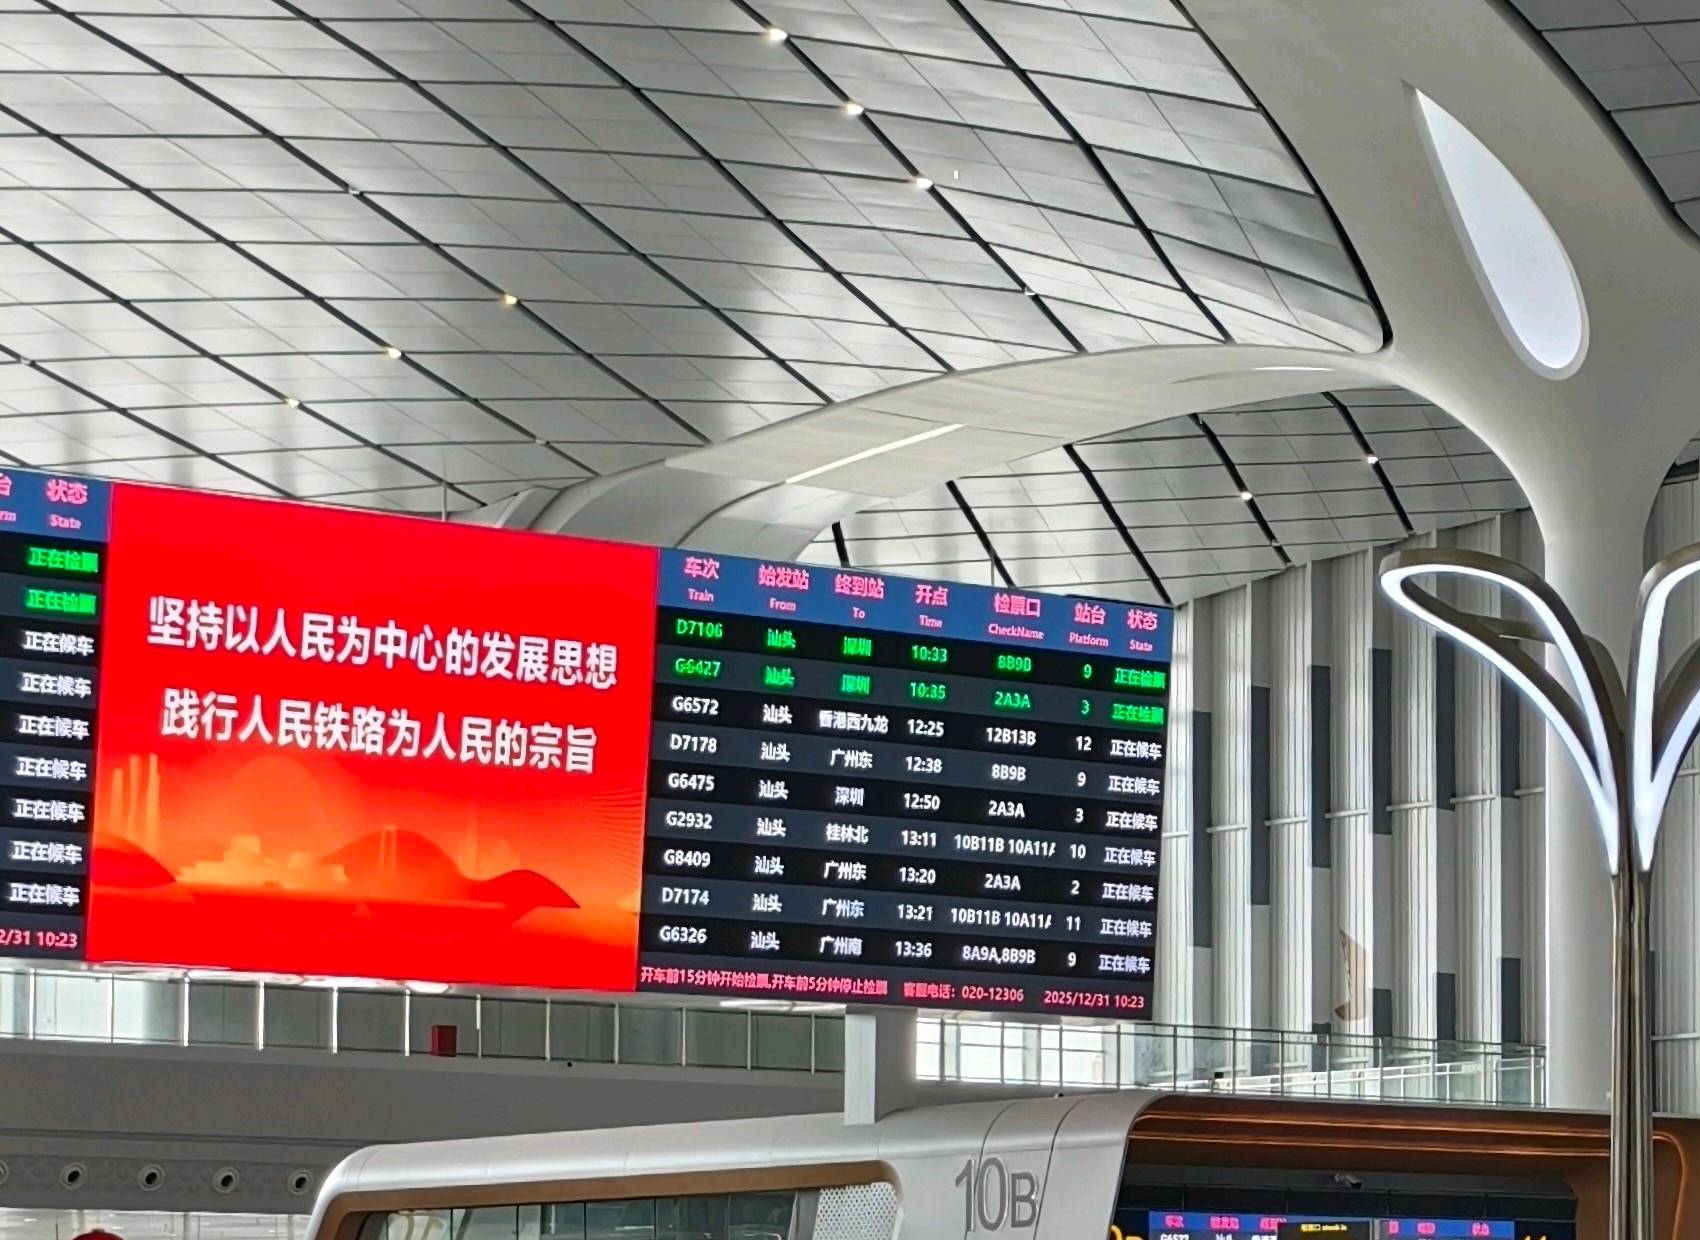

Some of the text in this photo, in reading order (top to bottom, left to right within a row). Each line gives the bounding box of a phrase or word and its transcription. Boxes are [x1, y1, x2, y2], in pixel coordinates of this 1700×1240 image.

[46, 479, 88, 504] 状态
[684, 557, 1157, 631] 车次 始发站 终到站 开点 检票口 站台 状态
[688, 588, 1153, 652] Train From To Time CheckName Platform State
[23, 631, 94, 656] 正在候车
[147, 595, 618, 690] 坚持以人民为中心的发展思想
[677, 619, 722, 639] D7106
[767, 629, 796, 649] 汕头
[912, 645, 948, 663] 10:33
[1083, 663, 1093, 679] 9
[20, 673, 91, 698] 正在候车
[675, 658, 722, 678] G6427
[765, 666, 795, 687] 汕头
[911, 683, 946, 700] 10:35
[995, 691, 1032, 709] 2A3A
[1081, 700, 1090, 715] 3
[19, 715, 89, 740] 正在候车
[160, 687, 597, 774] 践行人民铁路为人民的宗旨
[672, 696, 1161, 760] G6572 汕头 香港西九龙 12:25 12B13B 12 正在候车
[16, 757, 86, 781] 正在候车
[670, 734, 1159, 796] D7178 汕头 广州东 12:38 8B9B 9 正在候车
[13, 799, 84, 823] 正在候车
[668, 773, 1157, 831] G6475 汕头 深圳 12:50 2A3A 3 正在候车
[10, 841, 81, 865] 正在候车
[666, 811, 713, 830] G2932
[757, 818, 786, 838] 汕头
[826, 823, 869, 845] 桂林北
[902, 830, 937, 847] 13:11
[954, 834, 1005, 853] 10B11B
[1070, 844, 1087, 859] 10
[1104, 847, 1156, 867] 正在候车
[9, 883, 80, 907] 正在候车
[664, 849, 1154, 903] G8409 汕头 广州东 13:20 2A3A 2 正在候车
[662, 887, 710, 906] D7174
[752, 894, 783, 913] 汕头
[822, 898, 865, 919] 广州东
[898, 904, 933, 921] 13:21
[951, 908, 1001, 925] 10B11B
[1066, 915, 1081, 931] 11
[1100, 919, 1152, 938] 正在候车
[37, 931, 78, 949] 10:23
[660, 926, 1150, 974] G6326 汕头 广州南 13:36 8A9A,8B9B 9 正在候车
[1044, 990, 1110, 1007] 2025/12/31
[1114, 994, 1145, 1009] 10:23
[955, 1157, 1038, 1231] 10B
